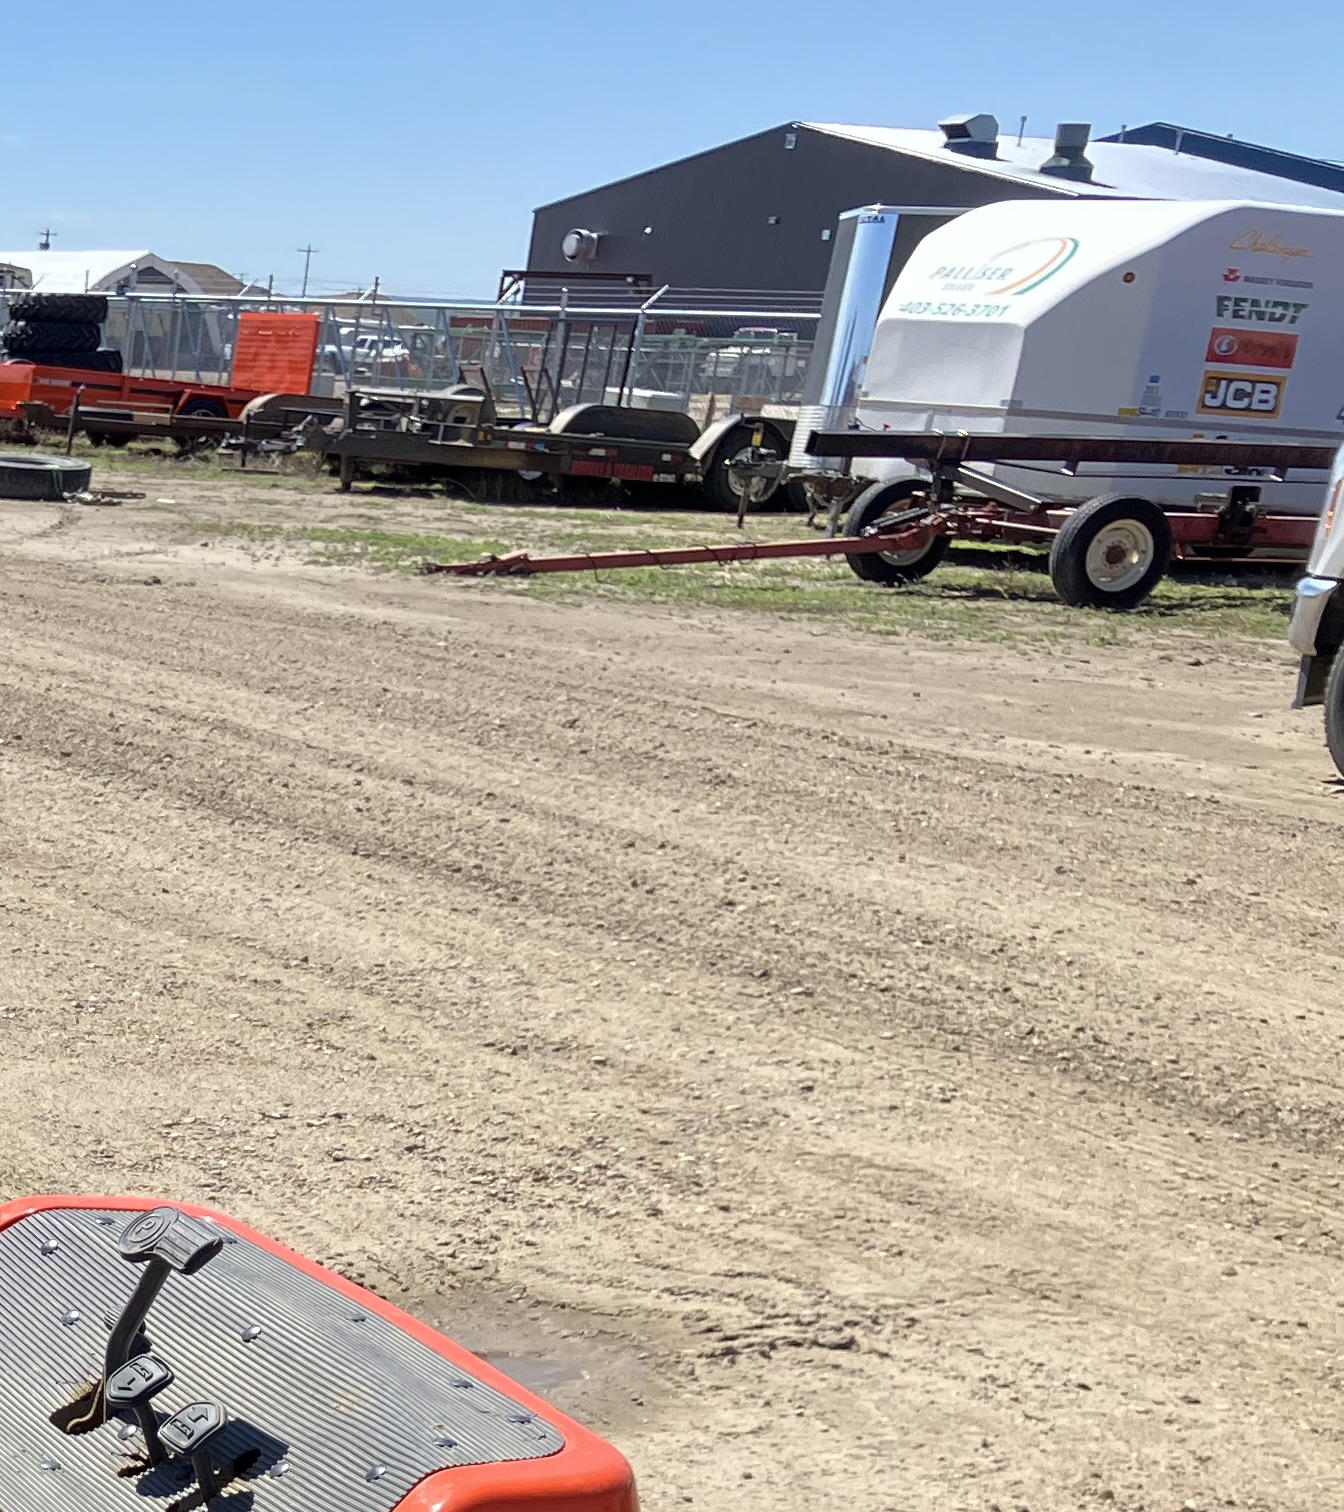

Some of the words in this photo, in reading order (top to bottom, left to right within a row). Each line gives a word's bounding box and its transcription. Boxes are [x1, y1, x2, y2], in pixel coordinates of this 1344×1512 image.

[928, 263, 1014, 280] PALLISER
[1215, 295, 1310, 325] FENDT
[1204, 379, 1279, 412] JCB
